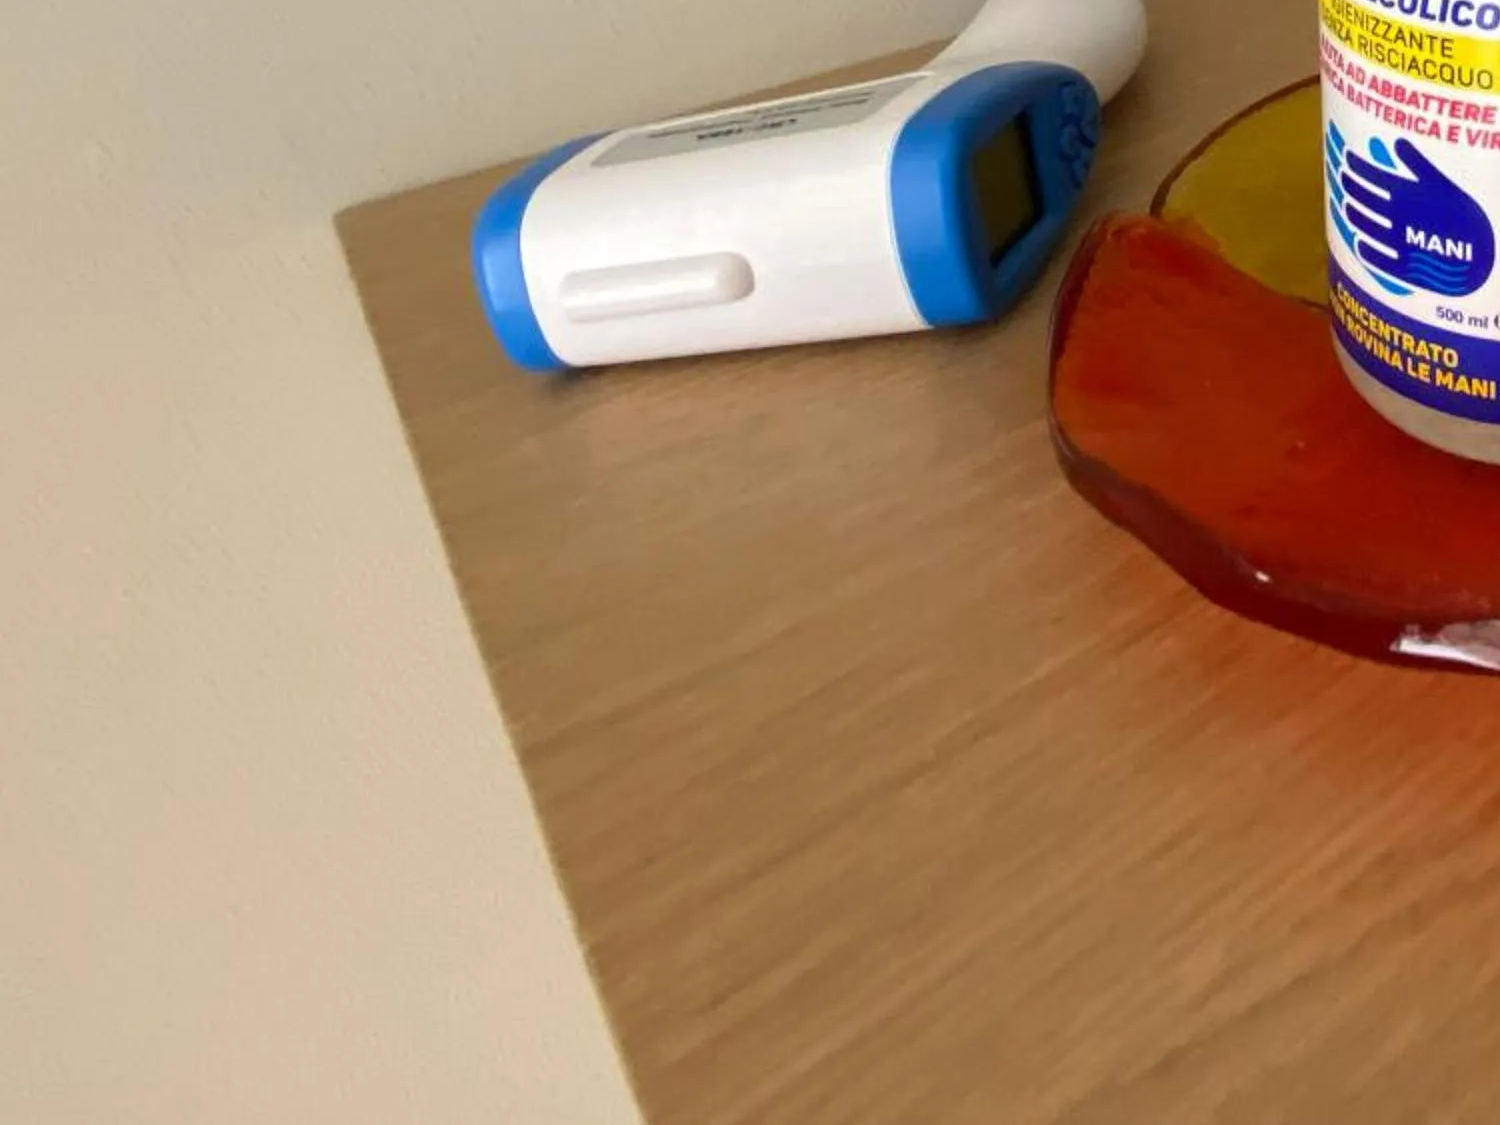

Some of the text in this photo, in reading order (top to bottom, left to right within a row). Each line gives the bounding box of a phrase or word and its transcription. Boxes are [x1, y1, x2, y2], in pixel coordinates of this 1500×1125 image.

[1358, 35, 1495, 90] RISCIACQUO
[1346, 63, 1366, 86] AD
[1368, 75, 1499, 125] ABBATTERE
[1348, 83, 1441, 140] BATTERICA
[1447, 125, 1459, 144] E
[1405, 225, 1473, 262] MANI
[1337, 282, 1460, 368] CONCENTRATO
[1436, 305, 1489, 329] 500 ml
[1407, 357, 1431, 383] LE
[1435, 368, 1497, 401] MANI
